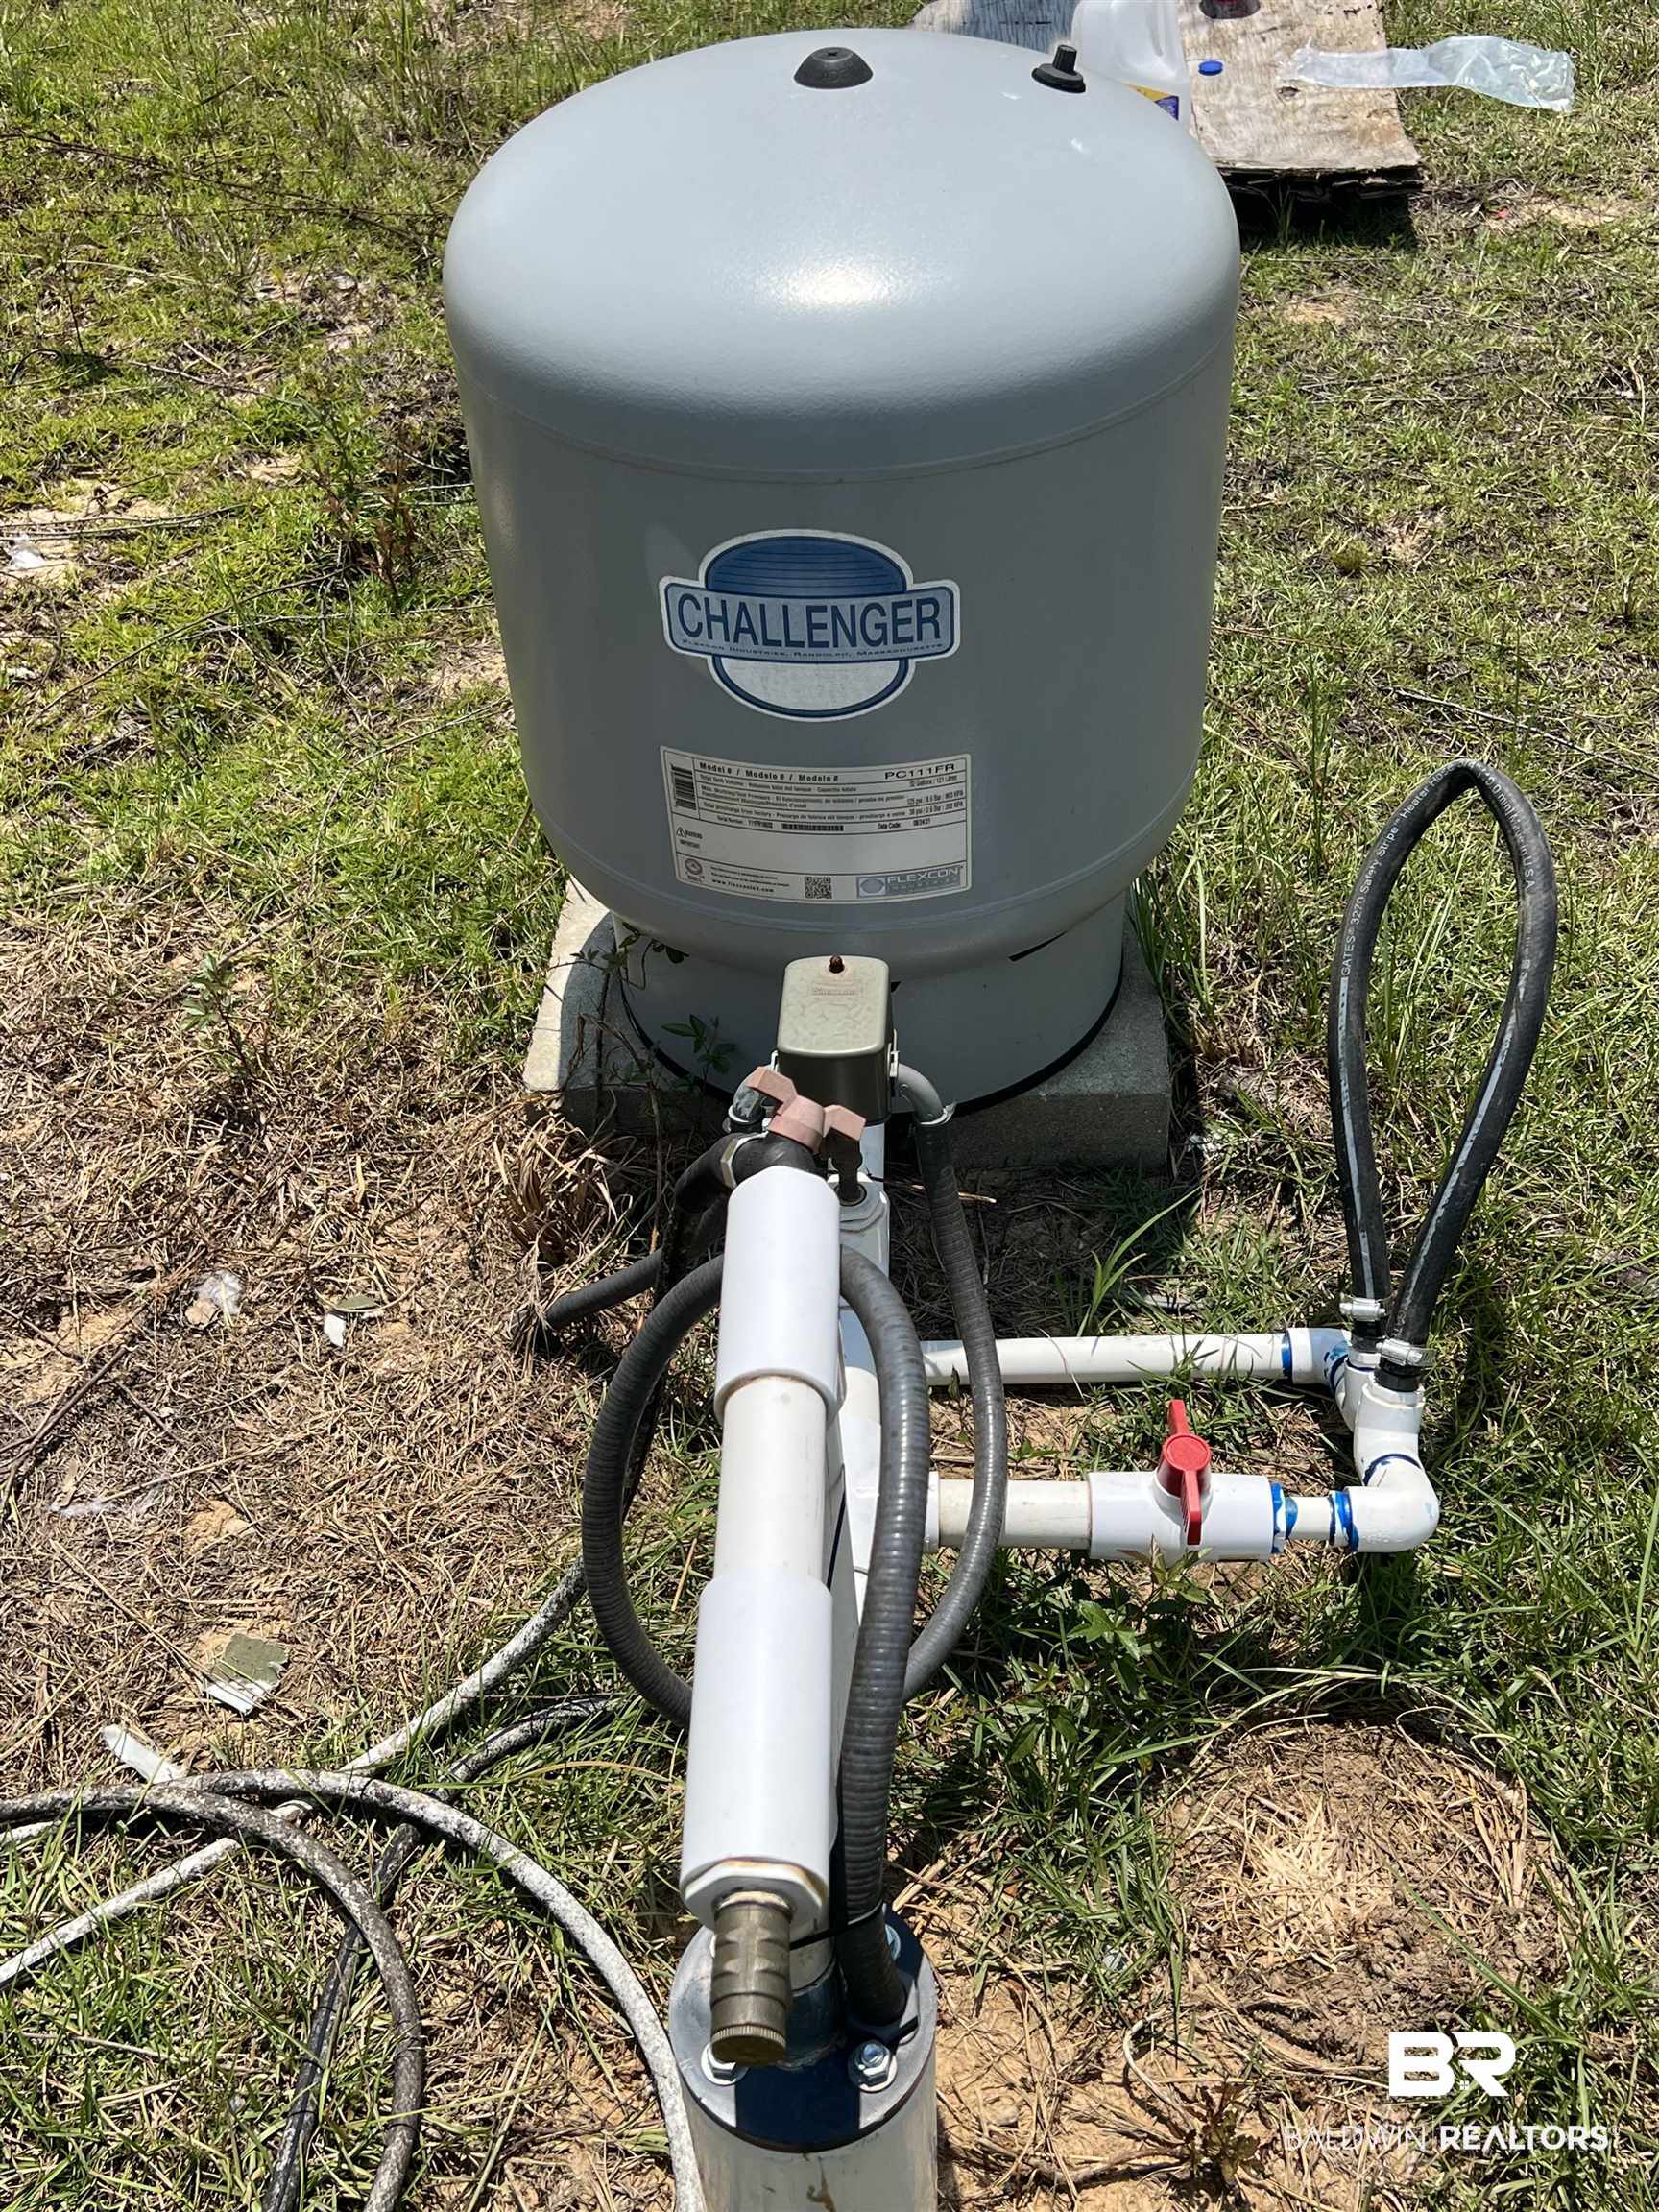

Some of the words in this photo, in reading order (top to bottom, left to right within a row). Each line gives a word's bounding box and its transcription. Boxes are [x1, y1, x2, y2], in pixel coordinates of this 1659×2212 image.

[677, 592, 942, 648] CHALLENGER
[884, 763, 956, 781] PC111FR
[887, 866, 959, 884] FLEXCON
[1350, 896, 1366, 926] 3270
[1359, 858, 1382, 895] Safety
